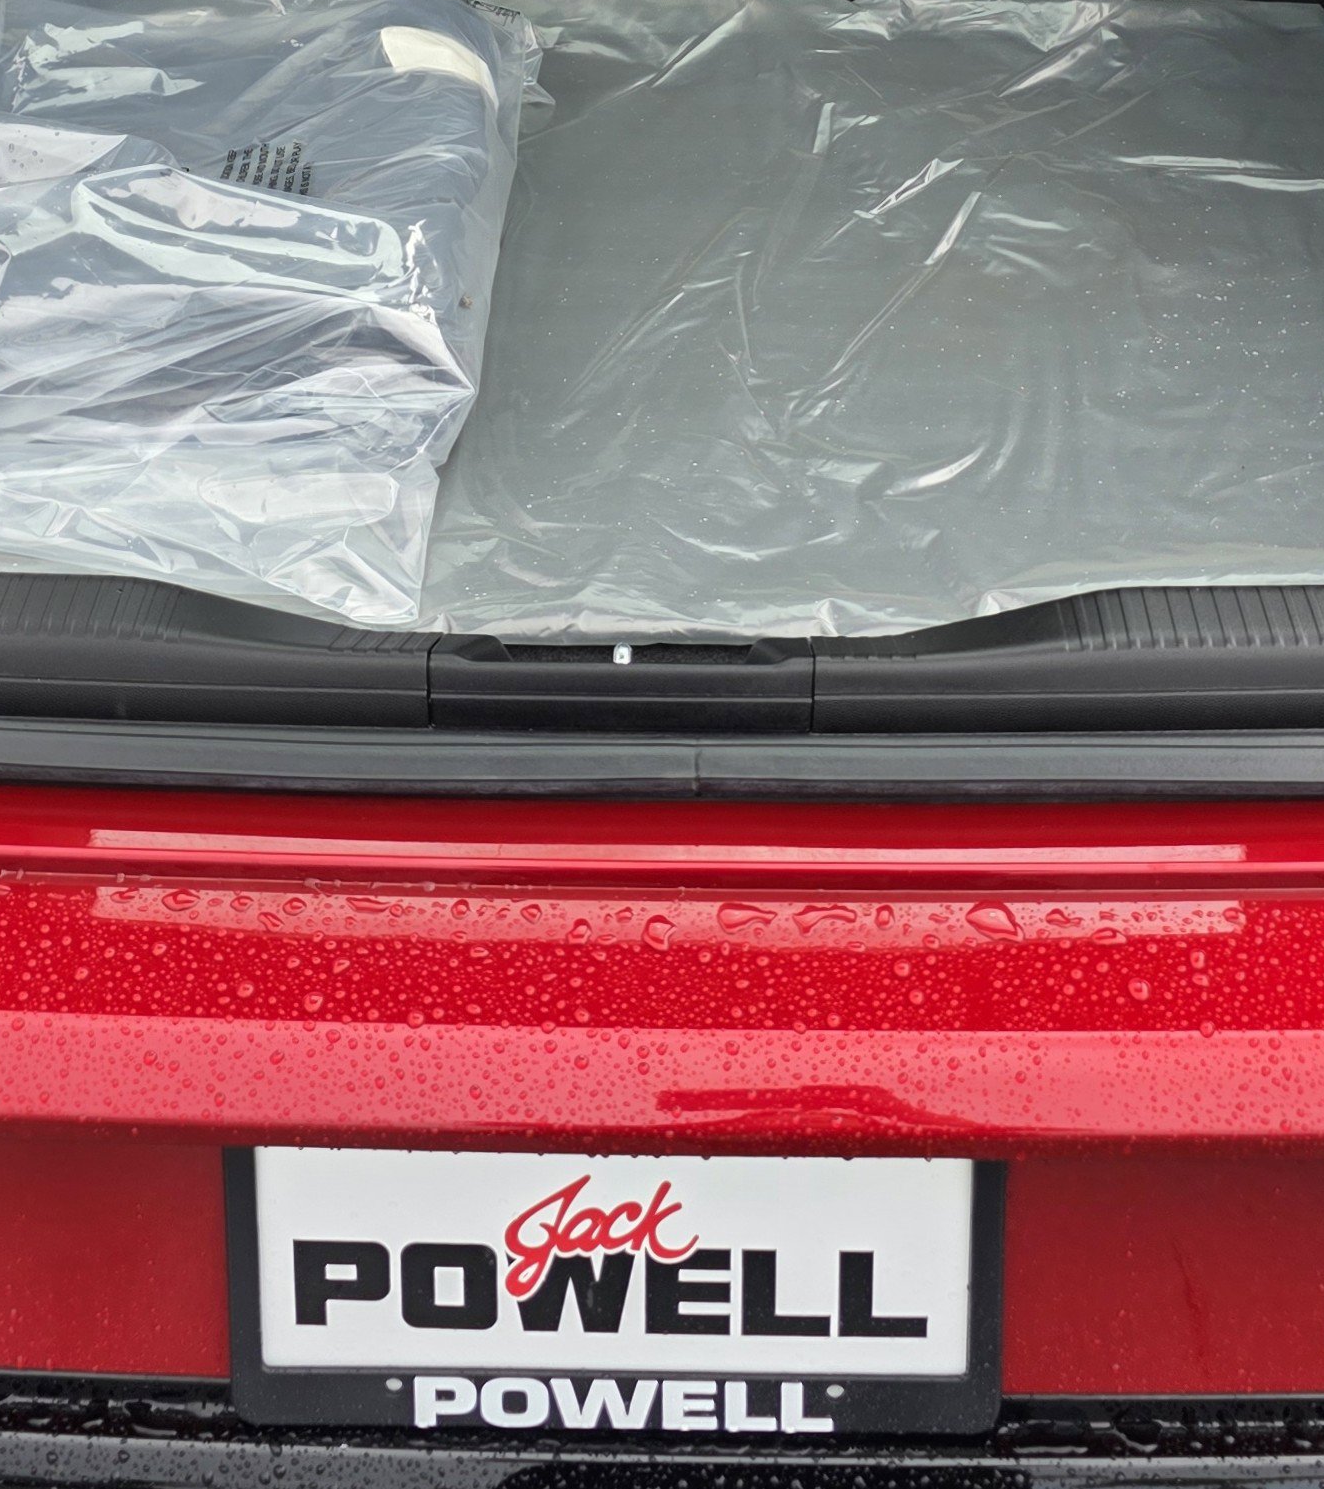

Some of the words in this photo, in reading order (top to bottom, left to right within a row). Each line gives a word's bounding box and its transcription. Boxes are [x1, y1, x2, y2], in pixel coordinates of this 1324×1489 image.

[504, 1174, 700, 1299] Jack
[292, 1239, 929, 1339] POWELL
[412, 1375, 834, 1434] POWELL
